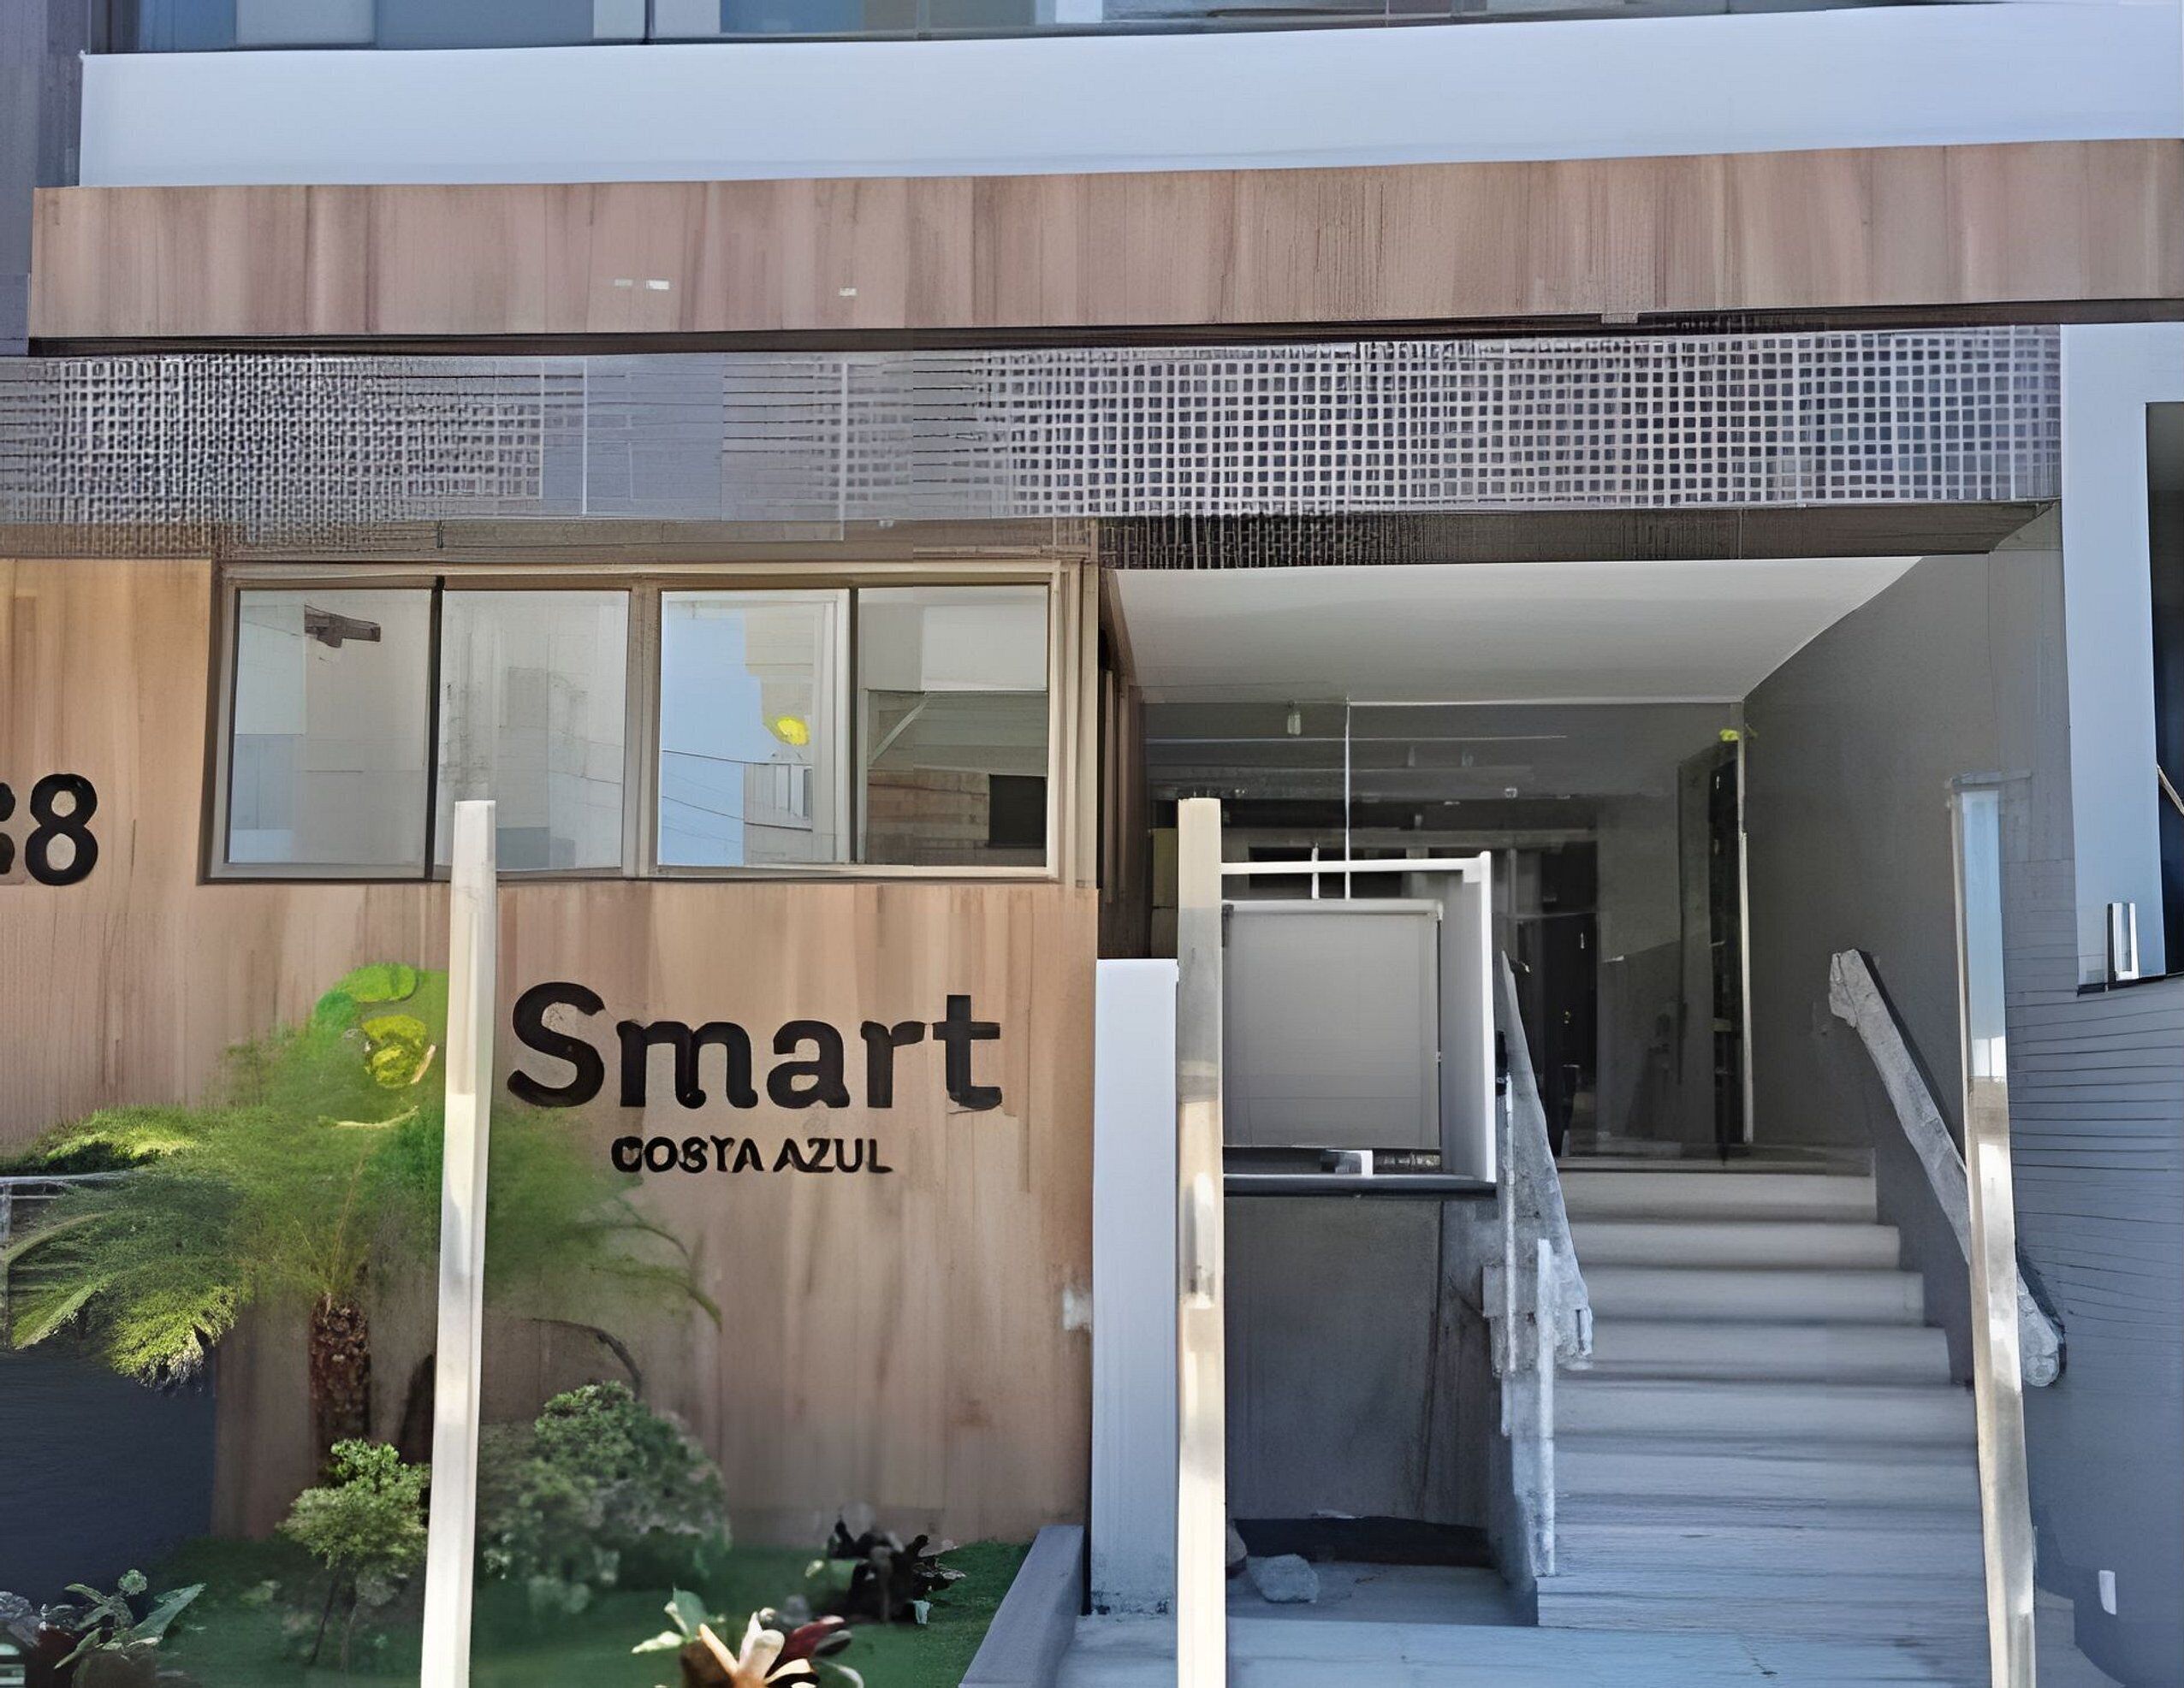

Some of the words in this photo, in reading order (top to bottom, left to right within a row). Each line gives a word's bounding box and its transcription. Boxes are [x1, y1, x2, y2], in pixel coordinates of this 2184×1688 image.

[0, 773, 98, 885] 8
[507, 981, 1003, 1110] Smart
[772, 1137, 893, 1173] AZUL
